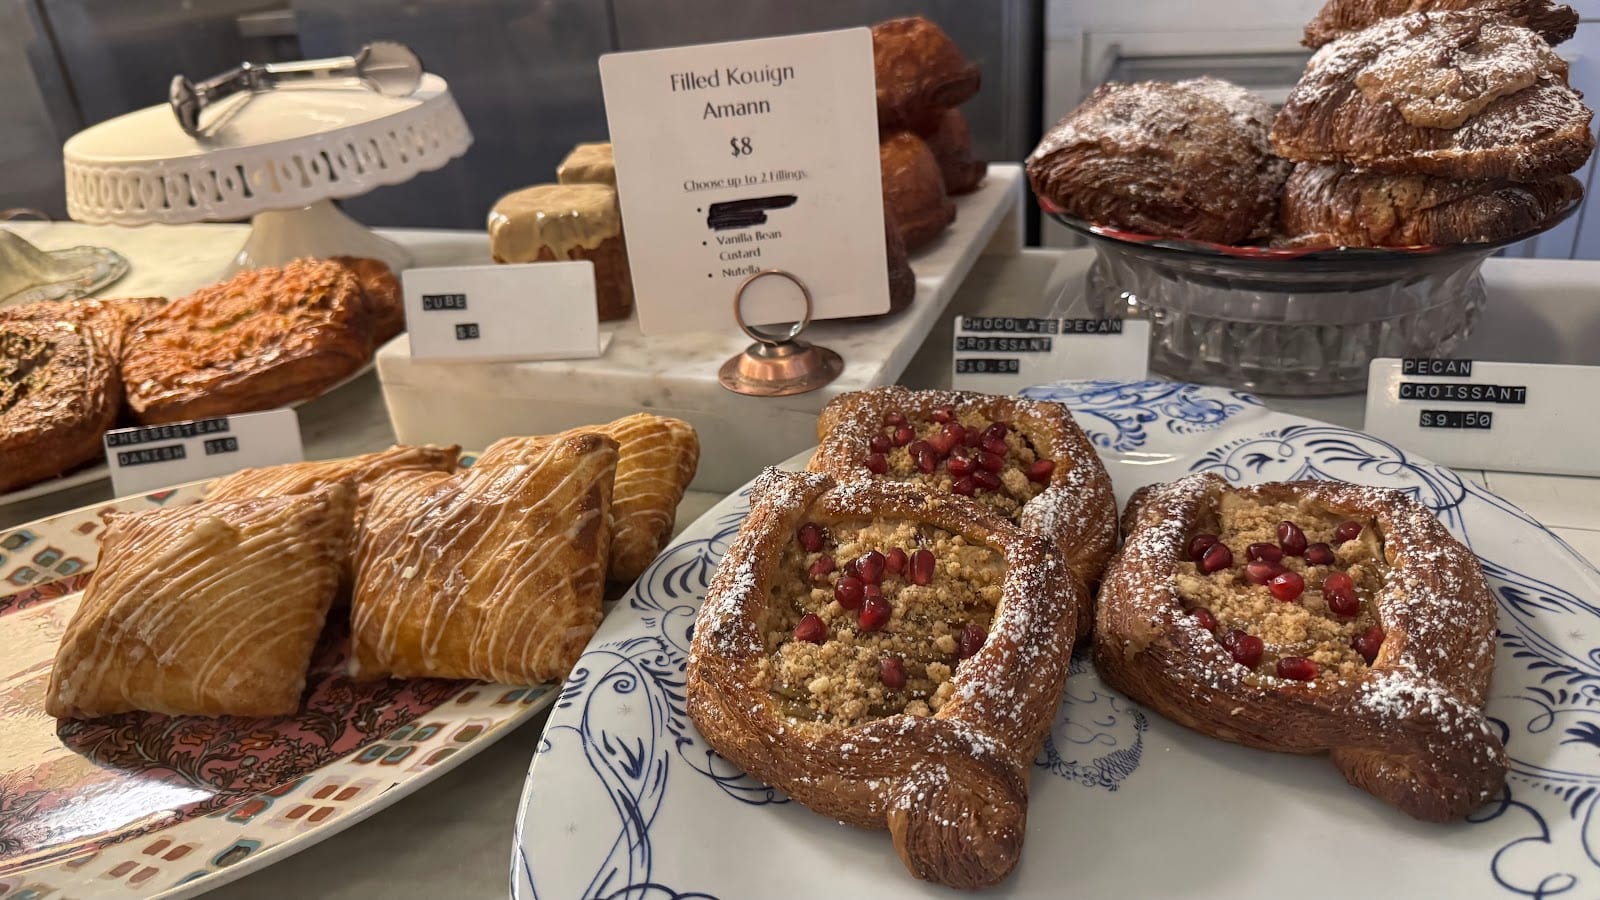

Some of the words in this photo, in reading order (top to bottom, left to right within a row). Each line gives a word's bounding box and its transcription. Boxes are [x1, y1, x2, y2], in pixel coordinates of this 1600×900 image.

[670, 68, 720, 92] Filled
[726, 63, 794, 87] Kouign
[703, 99, 771, 120] Amann
[730, 136, 753, 158] $8
[683, 179, 724, 191] Choose
[727, 177, 742, 188] up
[744, 174, 757, 185] to
[761, 171, 768, 183] 2
[716, 232, 752, 245] Vanilla
[755, 231, 782, 241] Bean
[720, 247, 761, 261] Custard
[722, 264, 761, 278] Nutella
[423, 295, 466, 309] CUBE
[962, 317, 1058, 334] CHOCOLATE
[1063, 319, 1122, 333] PECAN
[956, 337, 1051, 351] CROISSANT
[957, 360, 1018, 373] $10.50
[1403, 360, 1471, 374] PECAN
[1400, 384, 1526, 402] CROISSANT
[1421, 412, 1491, 427] $9.50
[107, 418, 228, 446] CHEESESTEAK
[119, 446, 185, 465] DANISH
